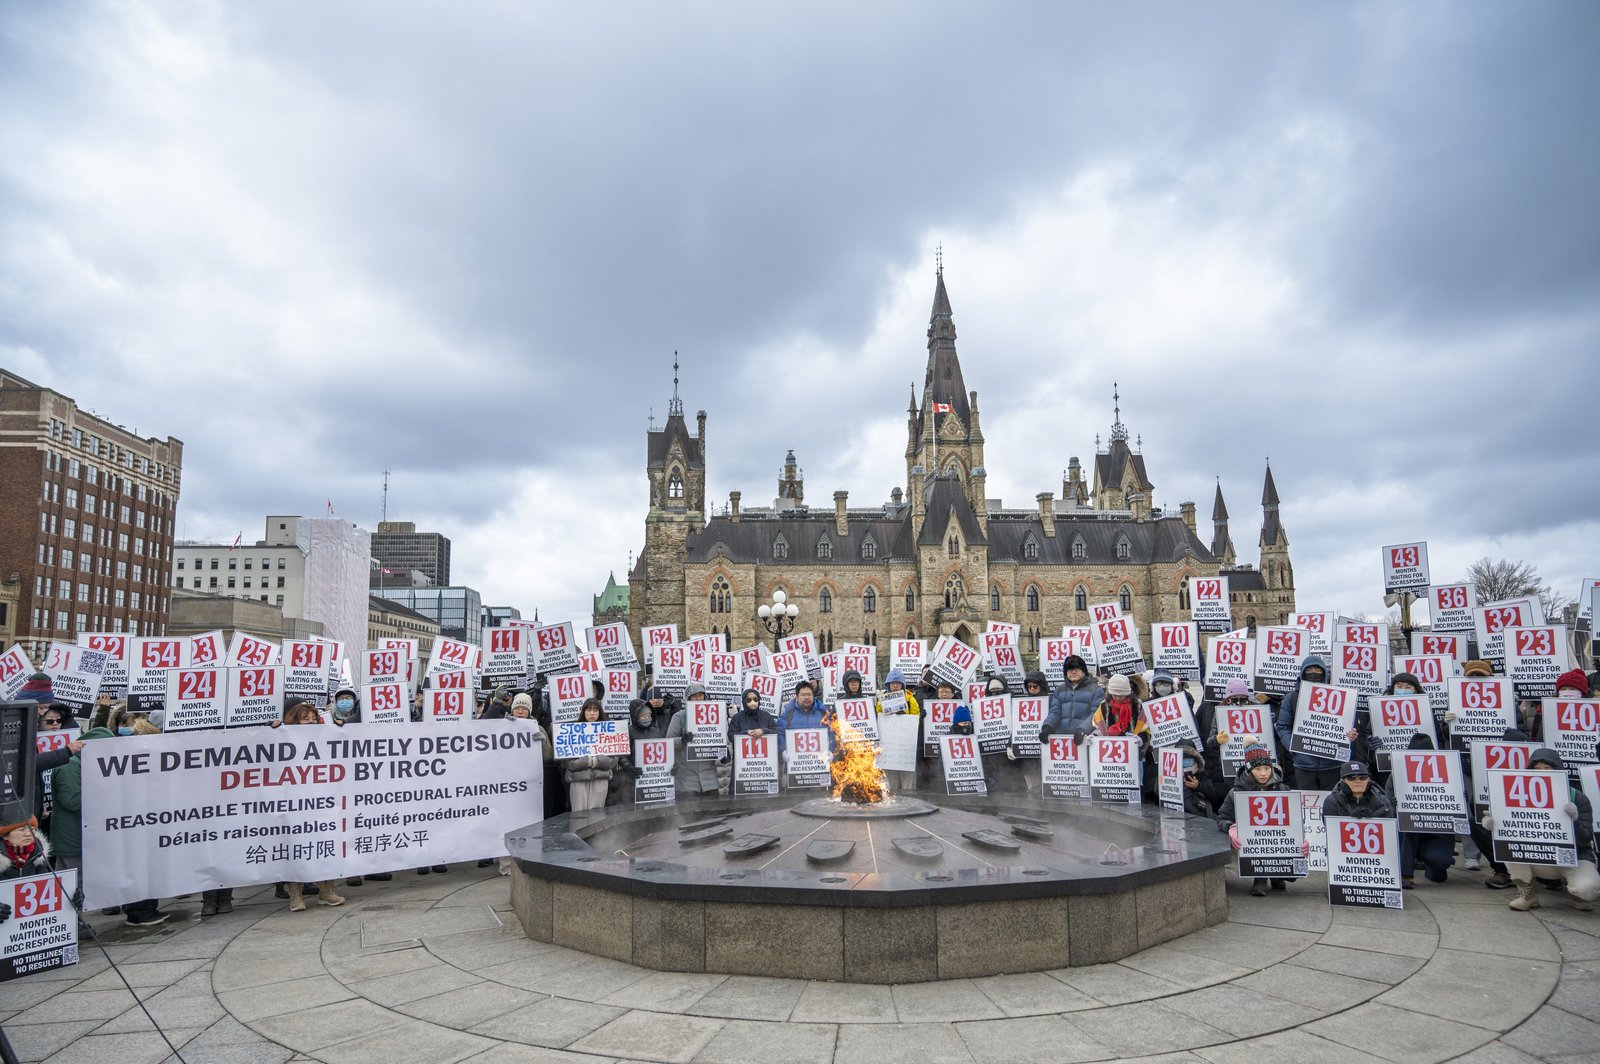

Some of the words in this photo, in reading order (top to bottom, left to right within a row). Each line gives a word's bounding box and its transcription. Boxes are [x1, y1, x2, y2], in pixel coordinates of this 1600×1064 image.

[1394, 547, 1418, 567] 43
[1199, 581, 1219, 599] 22
[1440, 587, 1464, 608] 36
[1488, 608, 1519, 633] 32
[495, 630, 515, 652] 11
[541, 628, 563, 650] 39
[598, 628, 617, 647] 20
[652, 629, 669, 645] 62
[1103, 621, 1125, 643] 13
[1164, 626, 1187, 646] 70
[901, 641, 918, 657] 16
[1050, 641, 1070, 660] 39
[1219, 641, 1243, 664] 68
[1271, 631, 1297, 655] 53
[1520, 630, 1551, 655] 23
[47, 648, 70, 672] 31
[145, 642, 177, 667] 54
[240, 640, 268, 666] 25
[295, 644, 318, 667] 31
[442, 642, 466, 664] 22
[663, 648, 683, 667] 39
[776, 653, 796, 673] 30
[949, 645, 973, 667] 30
[998, 648, 1014, 666] 32
[1346, 646, 1374, 670] 28
[372, 652, 395, 675] 39
[714, 655, 733, 674] 36
[849, 656, 867, 674] 30
[1409, 659, 1440, 683] 40
[1513, 665, 1544, 673] WAITING
[181, 672, 212, 699] 24
[242, 670, 270, 696] 34
[561, 678, 583, 699] 40
[610, 672, 630, 692] 39
[242, 698, 270, 706] MONTHS
[374, 685, 397, 710] 53
[437, 693, 460, 715] 19
[1312, 687, 1342, 715] 30
[1465, 682, 1496, 708] 65
[173, 710, 203, 719] WAITING
[181, 702, 211, 710] MONTHS
[234, 706, 263, 715] WAITING
[263, 705, 276, 713] FOR
[697, 704, 717, 724] 36
[846, 701, 866, 720] 20
[983, 698, 1004, 720] 55
[1020, 701, 1039, 721] 34
[1152, 698, 1179, 723] 34
[1385, 700, 1416, 726] 90
[1466, 710, 1497, 718] MONTHS
[168, 719, 185, 727] IRCC
[185, 716, 222, 725] RESPONSE
[230, 715, 246, 723] IRCC
[246, 712, 280, 722] RESPONSE
[1231, 710, 1258, 733] 30
[1458, 717, 1490, 726] WAITING
[1561, 703, 1597, 731] 40
[560, 723, 587, 734] STOP
[591, 722, 615, 733] THE
[745, 739, 764, 758] 11
[797, 732, 819, 752] 35
[953, 738, 973, 758] 51
[1054, 739, 1075, 760] 31
[1102, 741, 1126, 762] 23
[1312, 745, 1336, 755] RESULTS
[97, 753, 150, 777] WE
[160, 742, 297, 772] DEMAND
[303, 741, 321, 760] A
[327, 738, 413, 759] TIMELY
[419, 732, 532, 755] DECISION
[646, 742, 665, 763] 39
[1490, 746, 1525, 770] 20
[220, 763, 346, 790] DELAYED
[354, 761, 384, 781] BY
[390, 758, 447, 779] IRCC
[1163, 754, 1177, 778] 42
[1409, 755, 1443, 783] 71
[354, 787, 452, 806] PROCEDURAL
[455, 781, 528, 798] FAIRNESS
[1405, 794, 1438, 802] WAITING
[1412, 786, 1446, 794] MONTHS
[1509, 776, 1549, 807] 40
[105, 803, 238, 831] REASONABLE
[242, 796, 335, 815] TIMELINES
[1253, 797, 1286, 826] 34
[1401, 802, 1419, 810] IRCC
[1419, 803, 1461, 811] RESPONSE
[1511, 812, 1550, 820] MONTHS
[354, 812, 400, 829] Équité
[403, 805, 490, 826] procédurale
[1502, 820, 1541, 829] WAITING
[1543, 822, 1562, 830] FOR
[158, 829, 218, 848] Délais
[223, 820, 336, 840] raisonnables
[354, 830, 429, 853] 程序公平
[1246, 838, 1279, 846] WAITING
[1254, 829, 1286, 837] MONTHS
[1344, 823, 1381, 853] 36
[1498, 830, 1518, 838] IRCC
[1519, 830, 1568, 840] RESPONSE
[245, 840, 336, 864] 给出时限
[1243, 846, 1260, 854] IRCC
[1260, 846, 1300, 854] RESPONSE
[1524, 852, 1557, 861] RESULTS
[1260, 858, 1293, 866] TIMELINES
[1337, 866, 1372, 875] WAITING
[1374, 867, 1390, 875] FOR
[1346, 857, 1380, 866] MONTHS
[1333, 875, 1351, 883] IRCC
[1351, 875, 1396, 885] RESPONSE
[20, 878, 58, 917] 34
[20, 915, 57, 930] MONTHS
[9, 926, 47, 943] WAITING
[50, 923, 67, 934] FOR
[3, 940, 25, 955] IRCC
[26, 932, 72, 948] RESPONSE
[12, 957, 23, 966] NO
[24, 949, 63, 964] TIMELINES
[16, 965, 26, 974] NO
[28, 958, 60, 972] RESULTS
